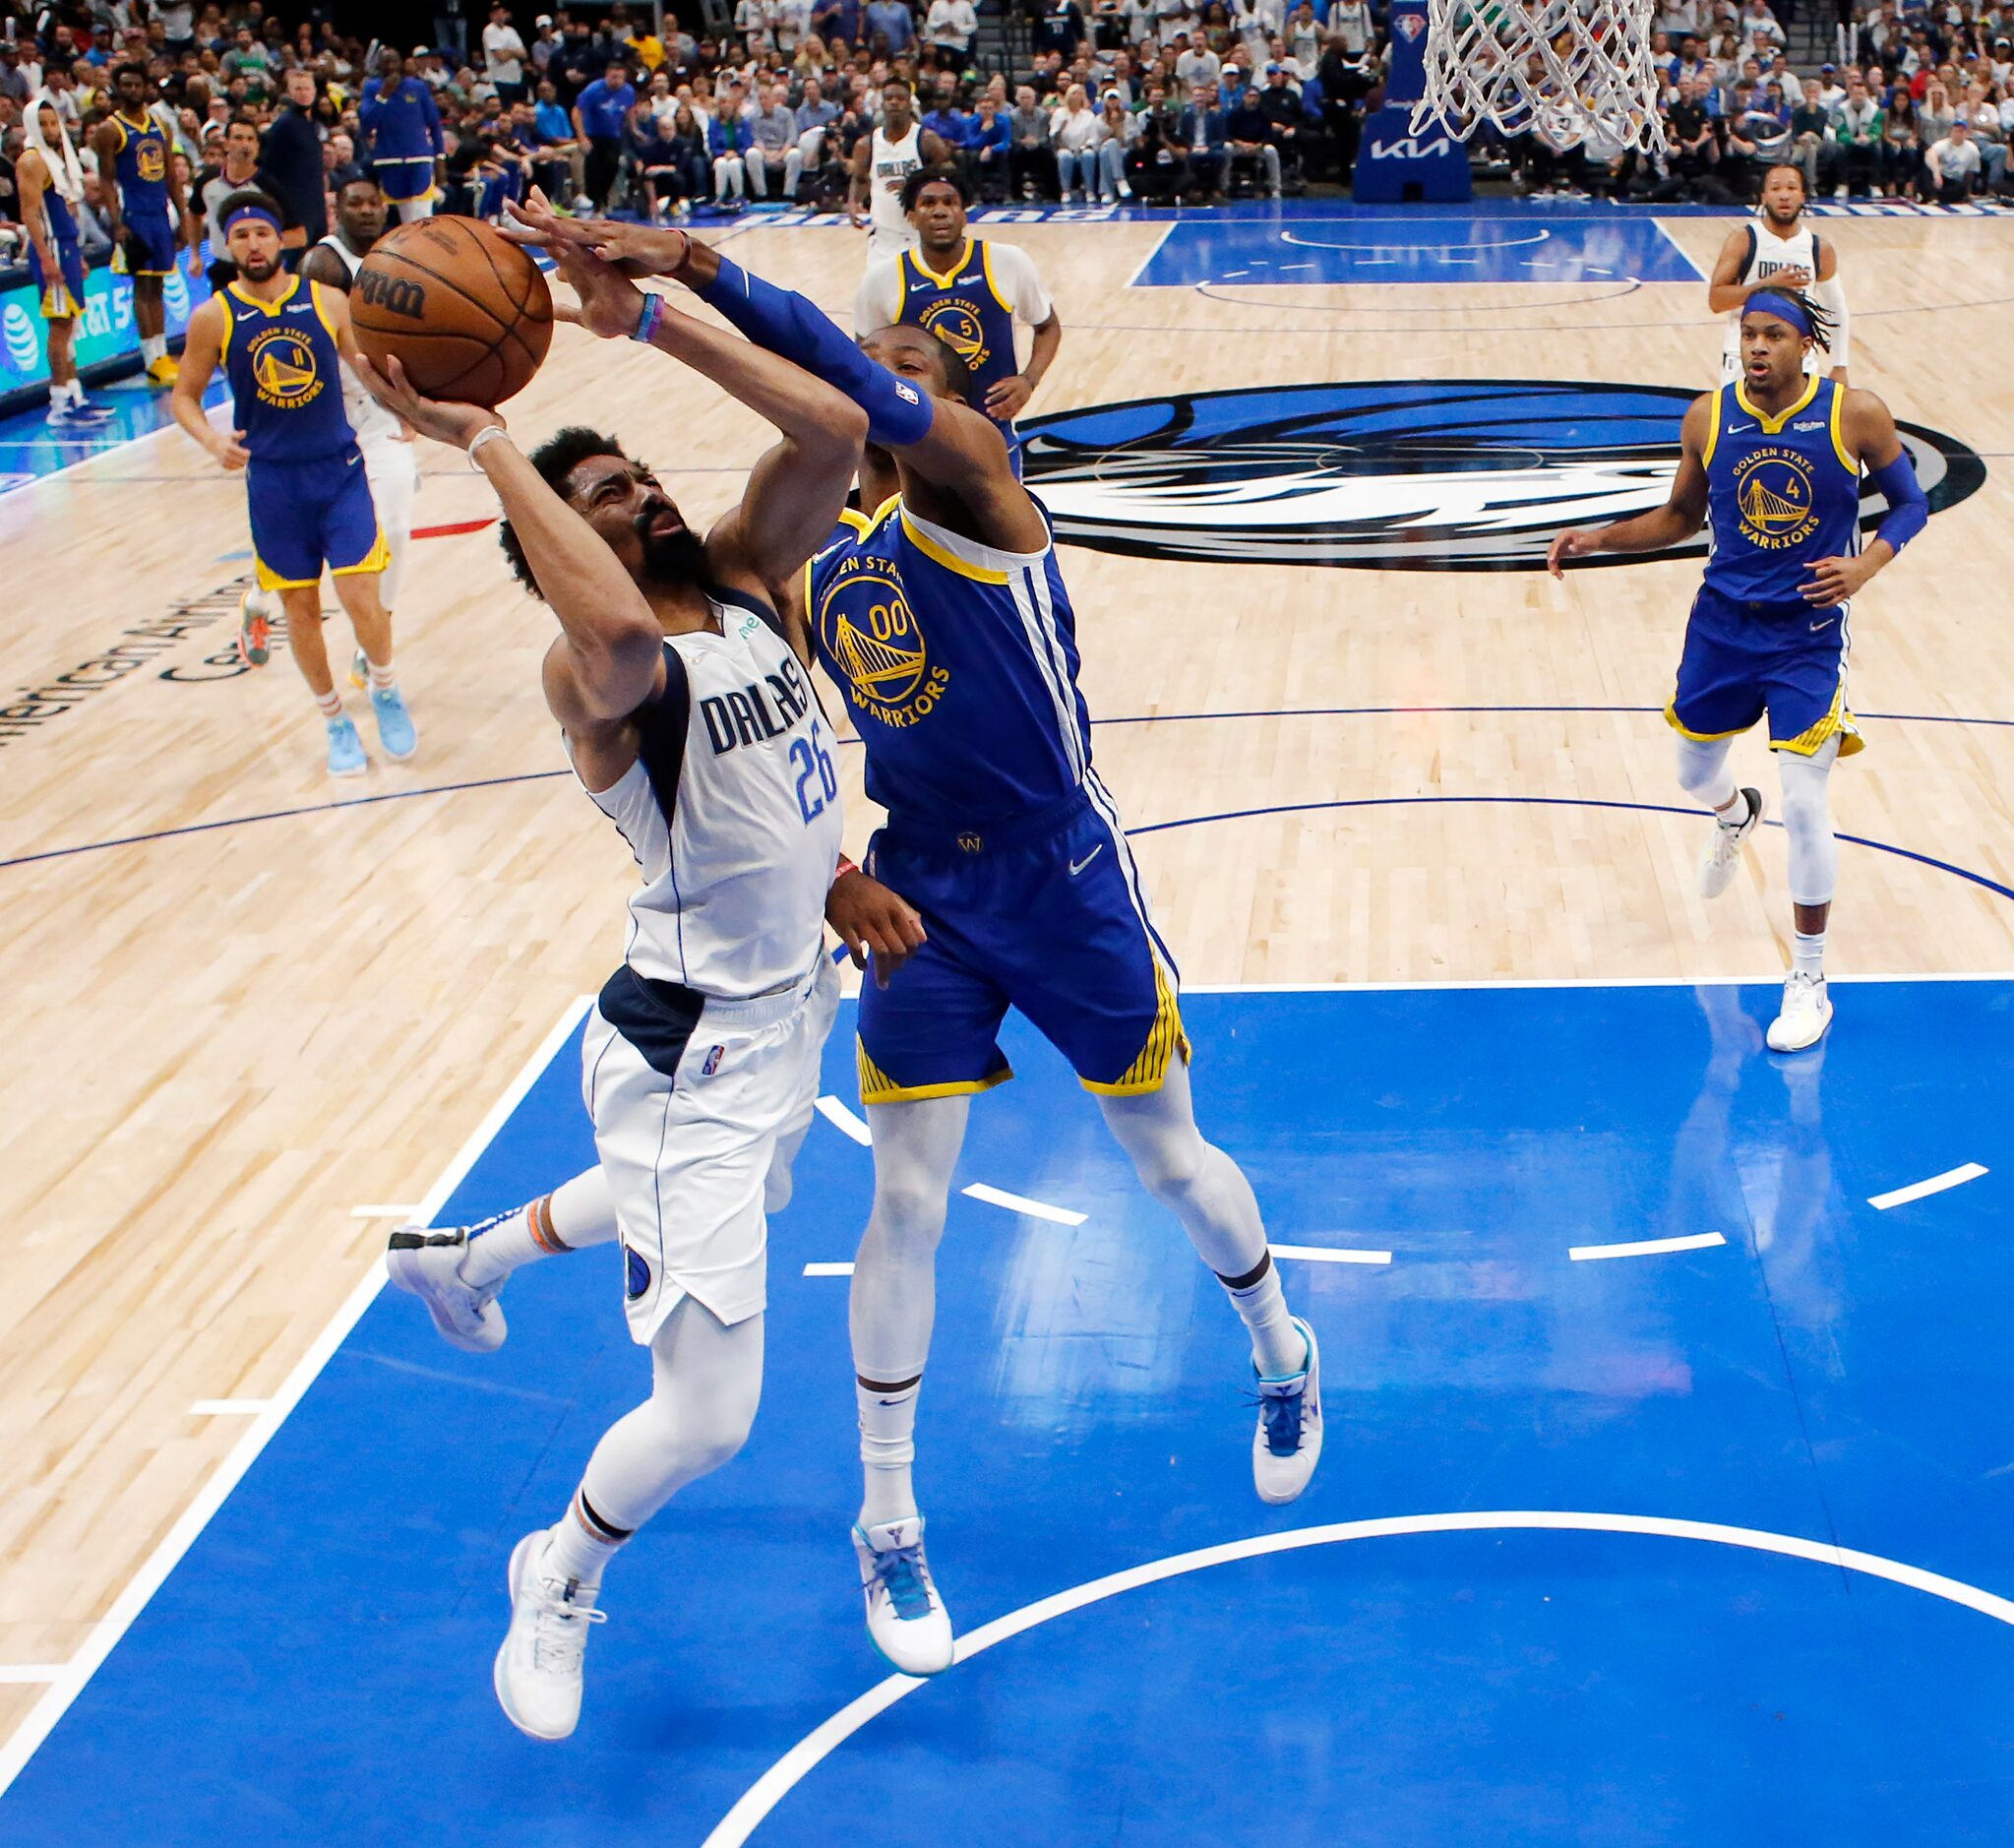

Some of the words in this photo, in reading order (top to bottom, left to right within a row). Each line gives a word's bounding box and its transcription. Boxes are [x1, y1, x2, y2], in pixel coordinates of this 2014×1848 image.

[1371, 138, 1450, 159] KIA
[918, 298, 951, 324] GOLDEN
[954, 298, 982, 315] STATE
[959, 319, 973, 337] 5
[256, 379, 325, 409] WARRIORS
[1733, 447, 1778, 476] GOLDEN
[1782, 449, 1815, 474] STATE
[1786, 476, 1800, 499] 4
[1739, 515, 1820, 550] WARRIORS
[869, 599, 909, 642] 00
[850, 665, 950, 728] WARRIORS
[789, 717, 837, 826] 26
